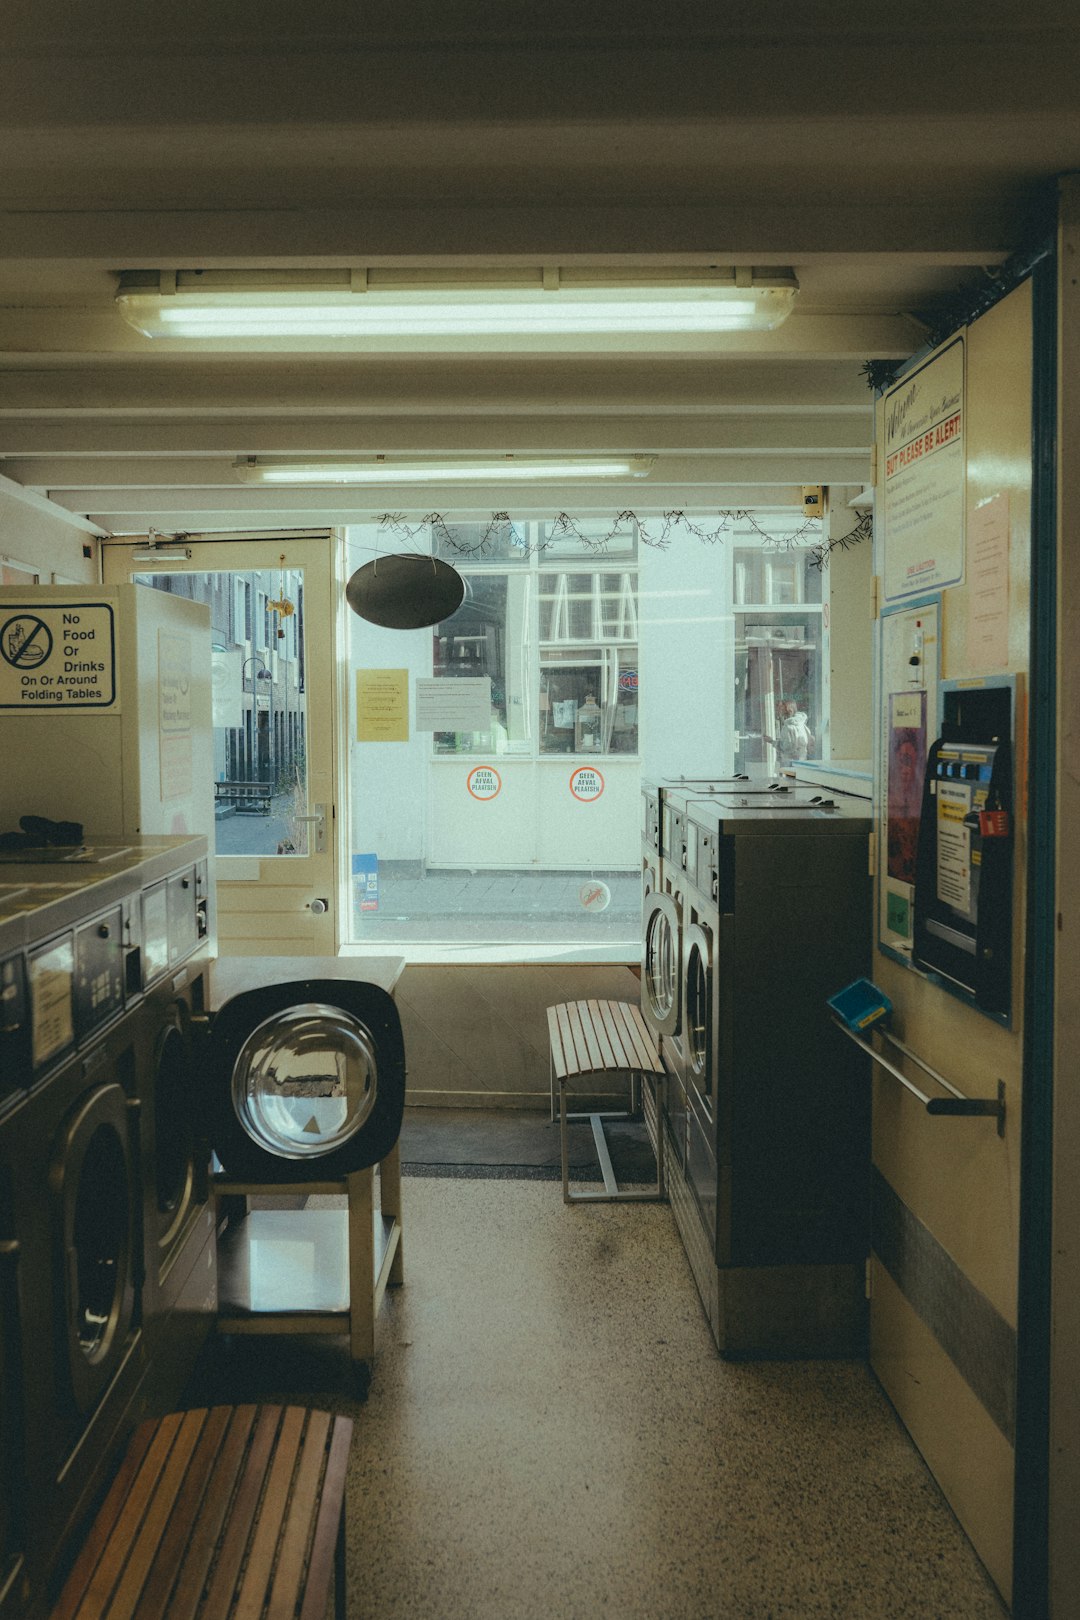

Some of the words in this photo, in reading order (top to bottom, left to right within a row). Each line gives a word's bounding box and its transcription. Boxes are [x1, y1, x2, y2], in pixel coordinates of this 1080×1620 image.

[886, 454, 898, 476] BUT
[899, 438, 923, 467] PLEASE
[924, 431, 933, 453] BE
[936, 414, 961, 446] ALERT!
[62, 613, 80, 624] No
[63, 629, 95, 640] Food
[63, 645, 79, 657] Or
[64, 661, 105, 672] Drinks
[21, 676, 37, 686] On
[40, 675, 53, 685] Or
[57, 674, 98, 685] Around
[21, 689, 63, 701] Folding
[66, 688, 102, 699] Tables
